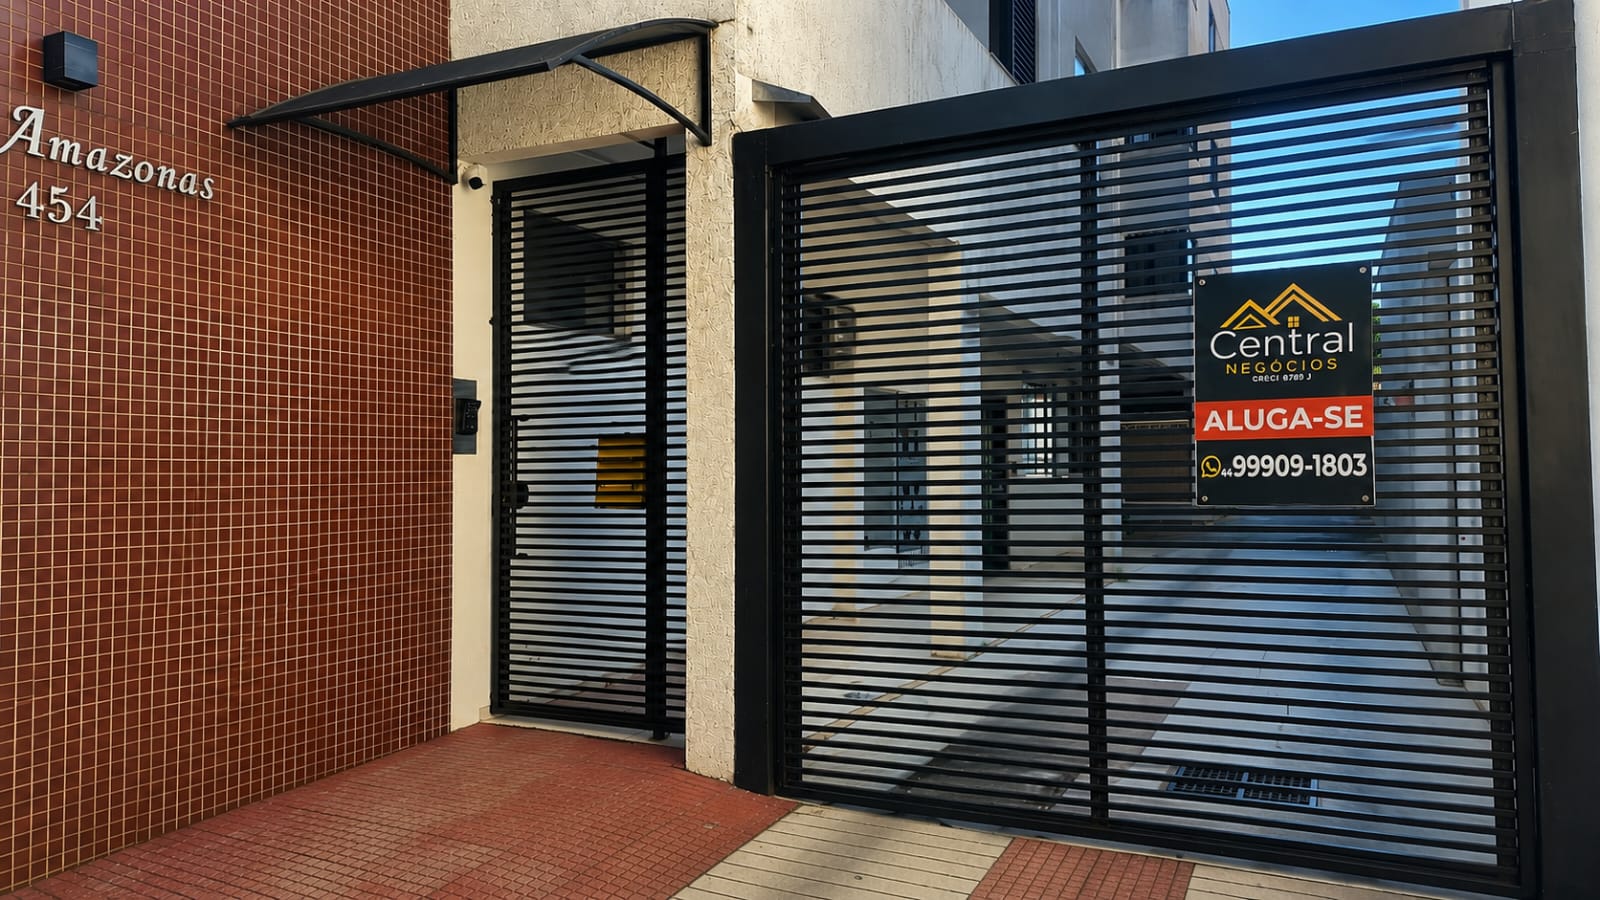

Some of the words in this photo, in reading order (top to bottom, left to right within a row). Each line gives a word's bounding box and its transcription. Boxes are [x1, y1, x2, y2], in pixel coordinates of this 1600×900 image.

[0, 105, 214, 200] Amazonas
[16, 181, 103, 231] 454
[1210, 322, 1353, 359] Central
[1226, 358, 1338, 375] NEGÓCIOS
[1252, 374, 1279, 382] CRECI
[1203, 405, 1363, 431] ALUGA-SE
[1232, 453, 1367, 477] 99909-1803
